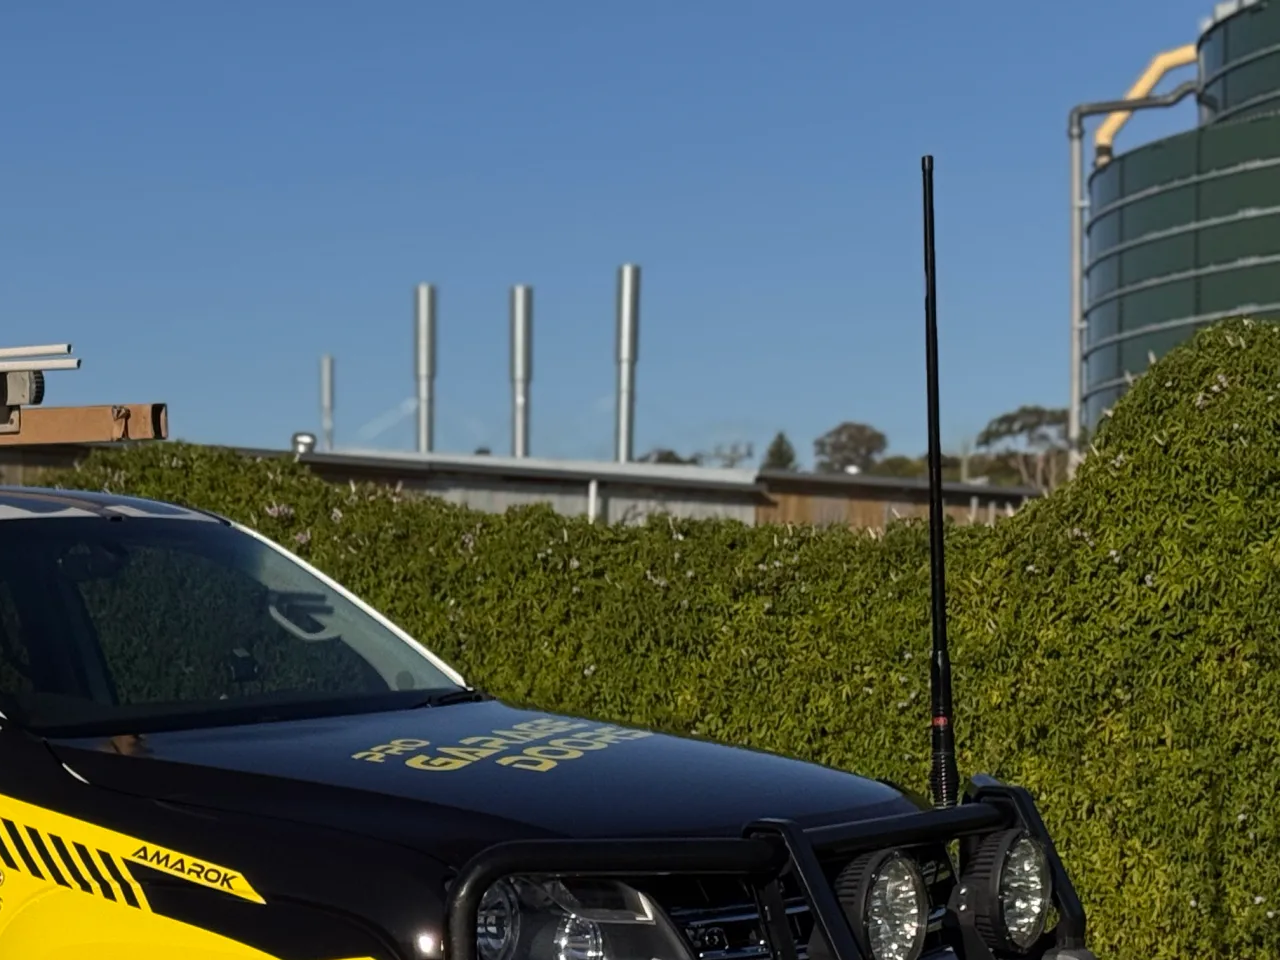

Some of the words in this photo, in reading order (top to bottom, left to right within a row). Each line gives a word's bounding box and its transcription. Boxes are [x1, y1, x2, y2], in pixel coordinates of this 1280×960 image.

[350, 738, 432, 764] PRO
[405, 718, 589, 772] GARAGE
[495, 725, 655, 773] DOORS
[131, 845, 239, 891] AMAROK
